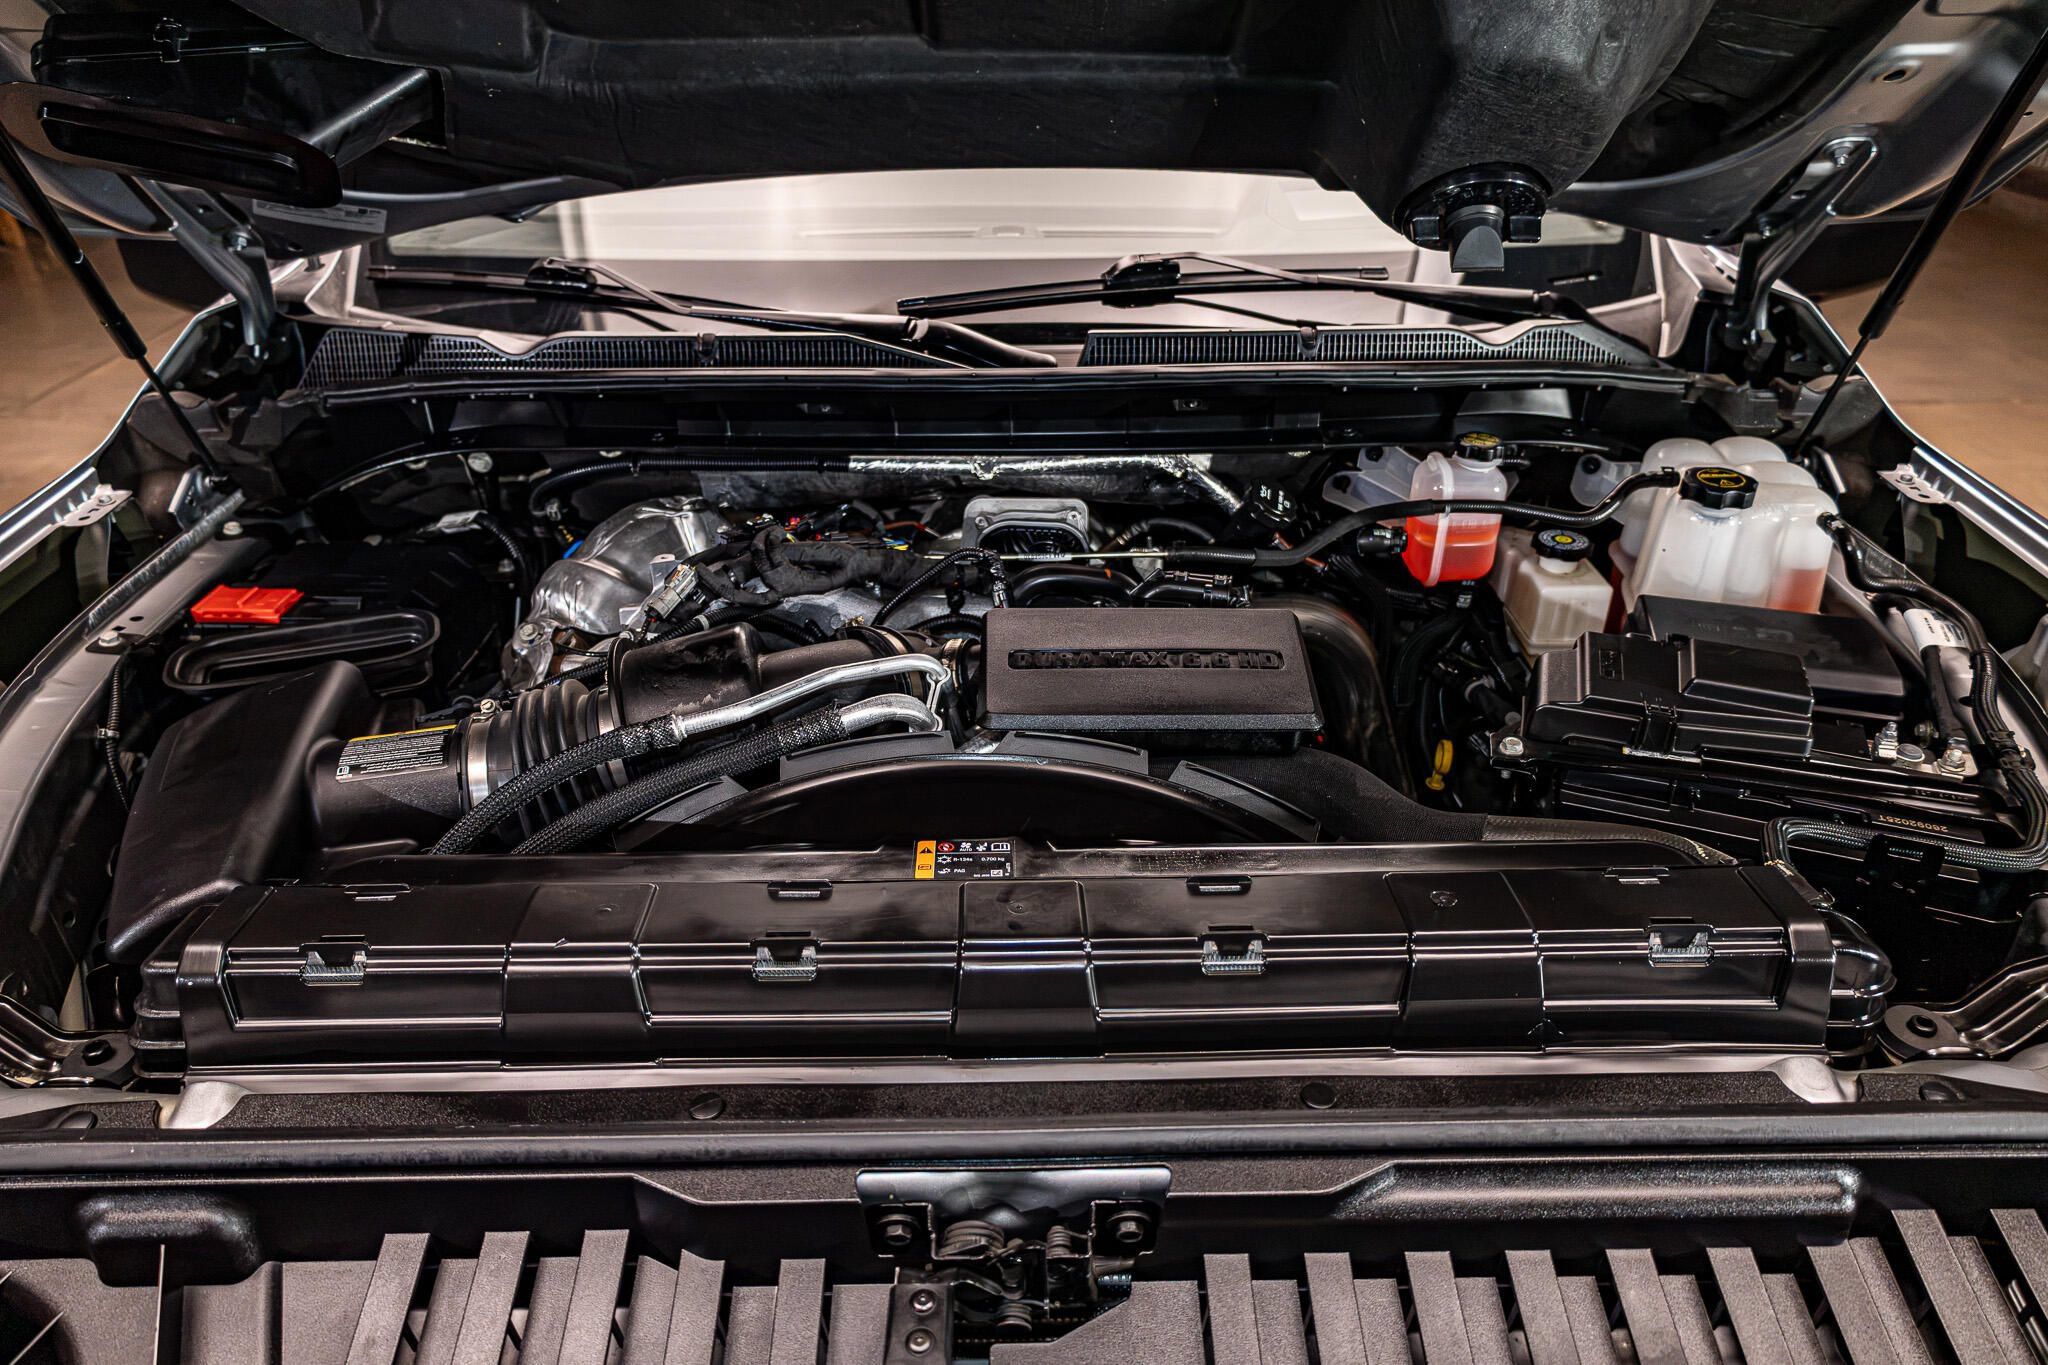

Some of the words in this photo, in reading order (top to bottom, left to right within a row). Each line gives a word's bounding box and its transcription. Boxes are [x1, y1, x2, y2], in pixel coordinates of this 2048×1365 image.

[1015, 650, 1170, 669] DURAMAX
[1182, 651, 1231, 669] 6.6
[1236, 651, 1281, 669] HD
